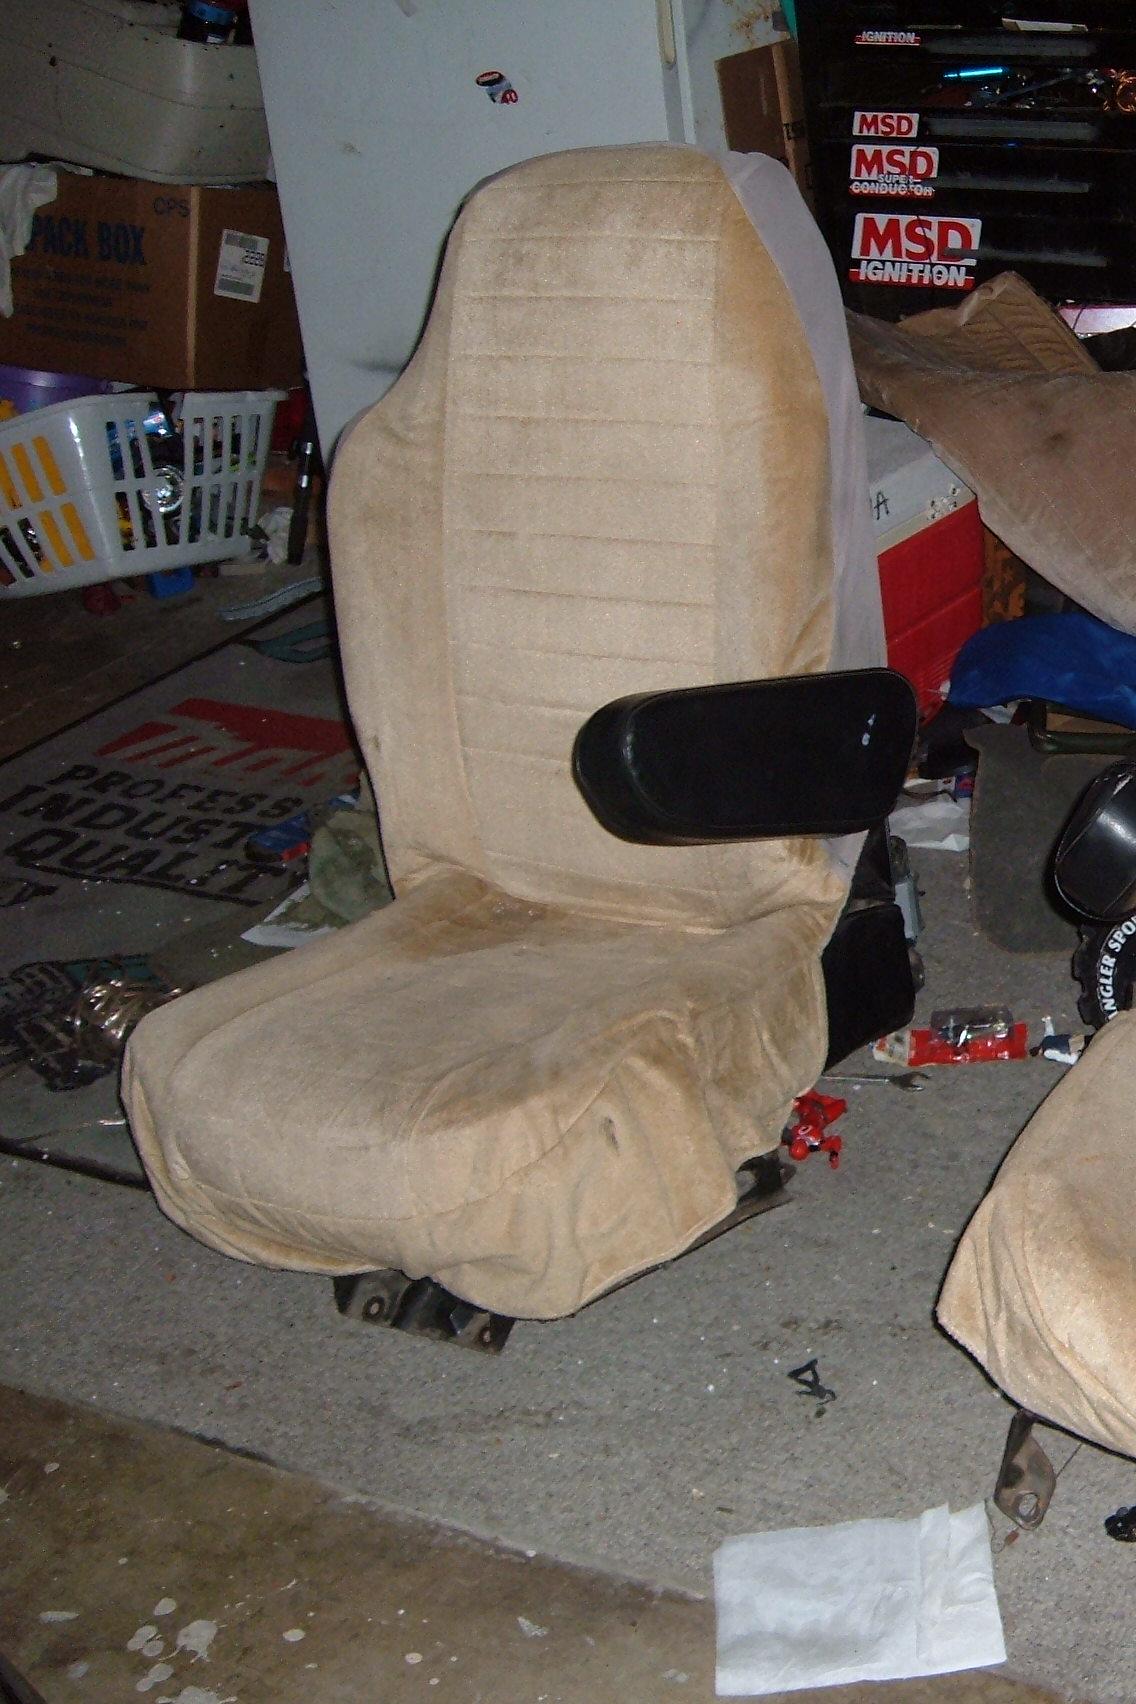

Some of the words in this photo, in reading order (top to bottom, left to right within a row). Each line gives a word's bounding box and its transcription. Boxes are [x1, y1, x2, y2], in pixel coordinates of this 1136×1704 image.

[861, 31, 916, 43] IGNITION
[858, 113, 913, 137] MSD
[854, 148, 934, 180] MSD
[850, 181, 934, 197] CONDUCTOR
[97, 220, 146, 266] BOX
[861, 217, 973, 262] MSD
[860, 260, 967, 287] IGNITION
